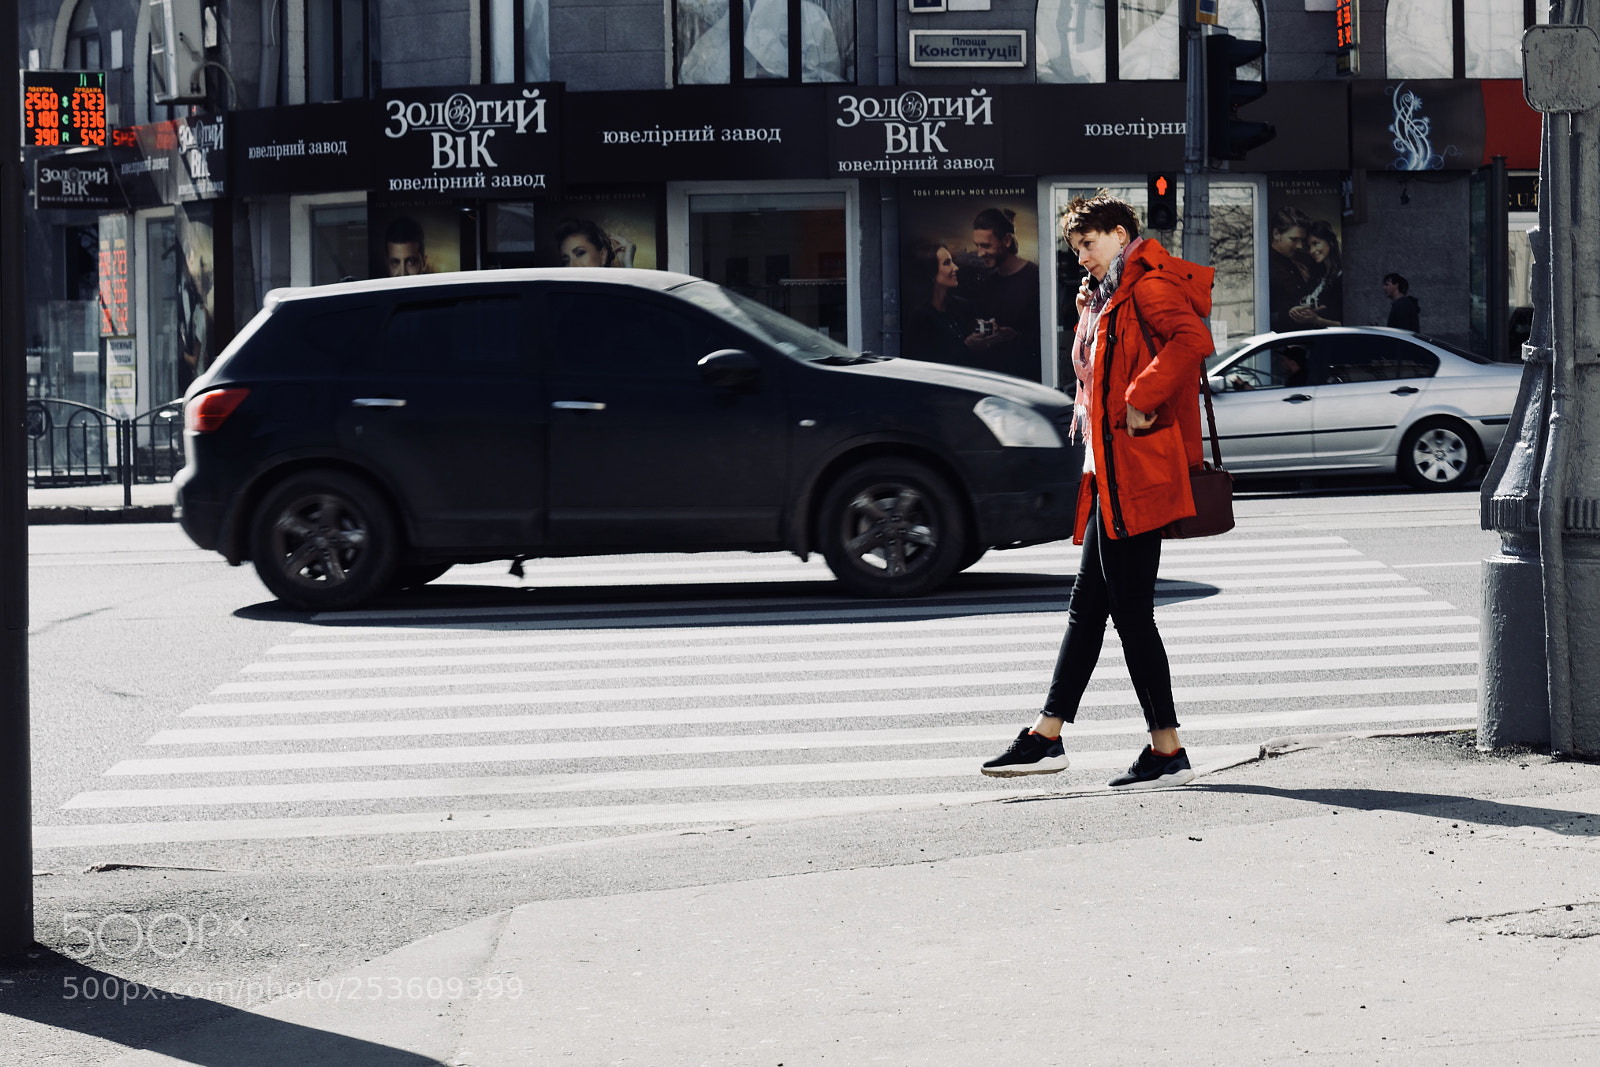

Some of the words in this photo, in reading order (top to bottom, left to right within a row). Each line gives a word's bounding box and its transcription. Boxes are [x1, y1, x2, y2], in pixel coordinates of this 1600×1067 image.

[952, 37, 987, 47] Площа
[919, 44, 1018, 60] Конституції
[25, 92, 59, 110] 2560
[72, 92, 105, 110] 2723
[26, 110, 59, 128] 3180
[73, 110, 105, 128] 3336
[1084, 117, 1187, 139] ювелірни
[35, 128, 59, 146] 390
[80, 128, 106, 146] 542
[602, 125, 716, 146] ювелірний
[721, 128, 782, 143] завод
[884, 121, 949, 153] ВІК
[248, 139, 305, 160] ювелірний
[308, 141, 348, 156] завод
[431, 129, 498, 169] ВІК
[838, 155, 938, 174] ювелірний
[943, 158, 995, 171] завод
[389, 172, 486, 193] ювелірний
[491, 174, 546, 189] завод
[988, 188, 1025, 196] КОХАННЯ
